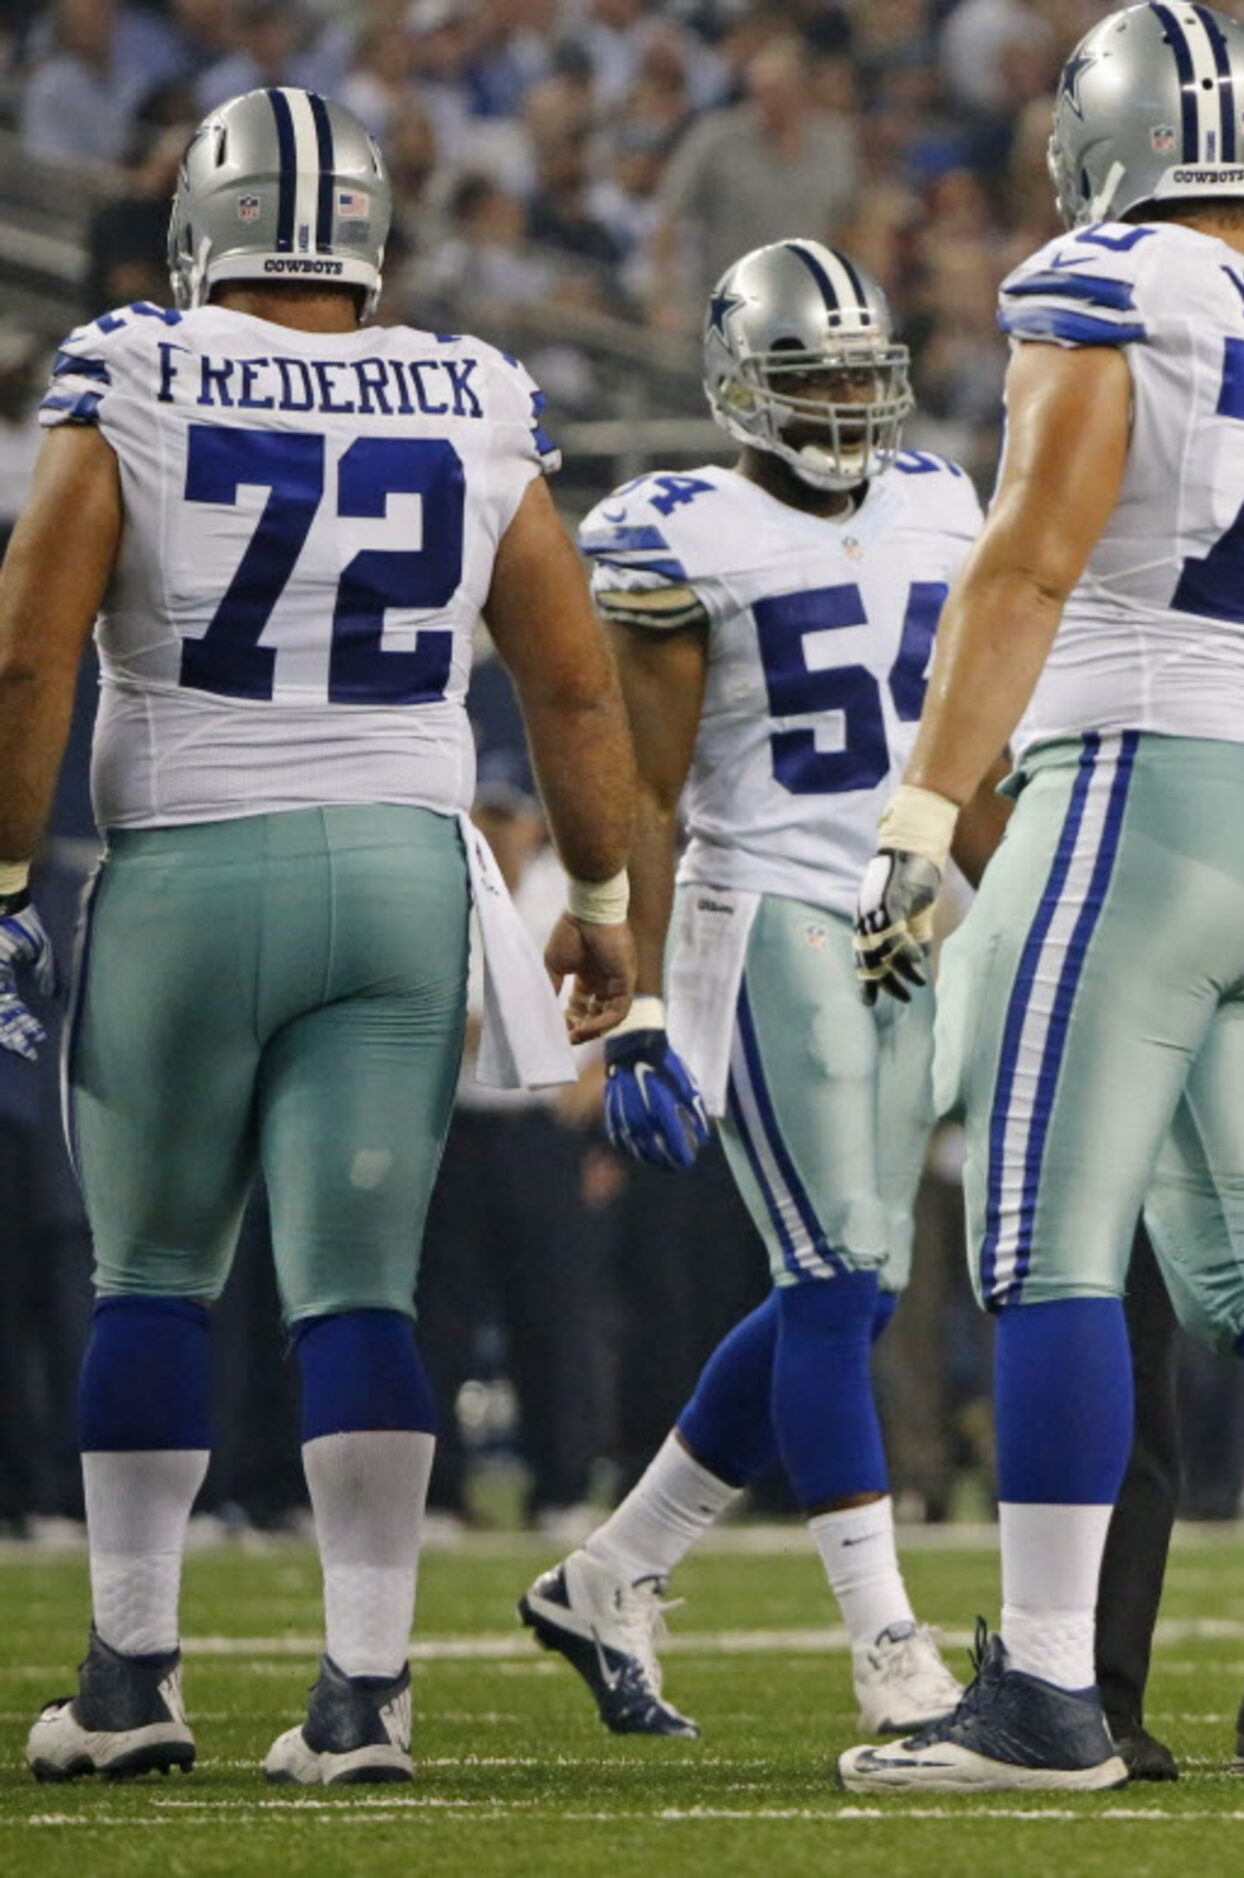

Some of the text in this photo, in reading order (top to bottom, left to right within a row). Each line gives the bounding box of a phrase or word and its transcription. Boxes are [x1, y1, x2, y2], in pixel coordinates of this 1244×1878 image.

[1173, 169, 1244, 183] COWBOYS
[264, 259, 343, 275] COWBOYS
[157, 341, 483, 418] FREDERICK
[178, 424, 467, 705] 72
